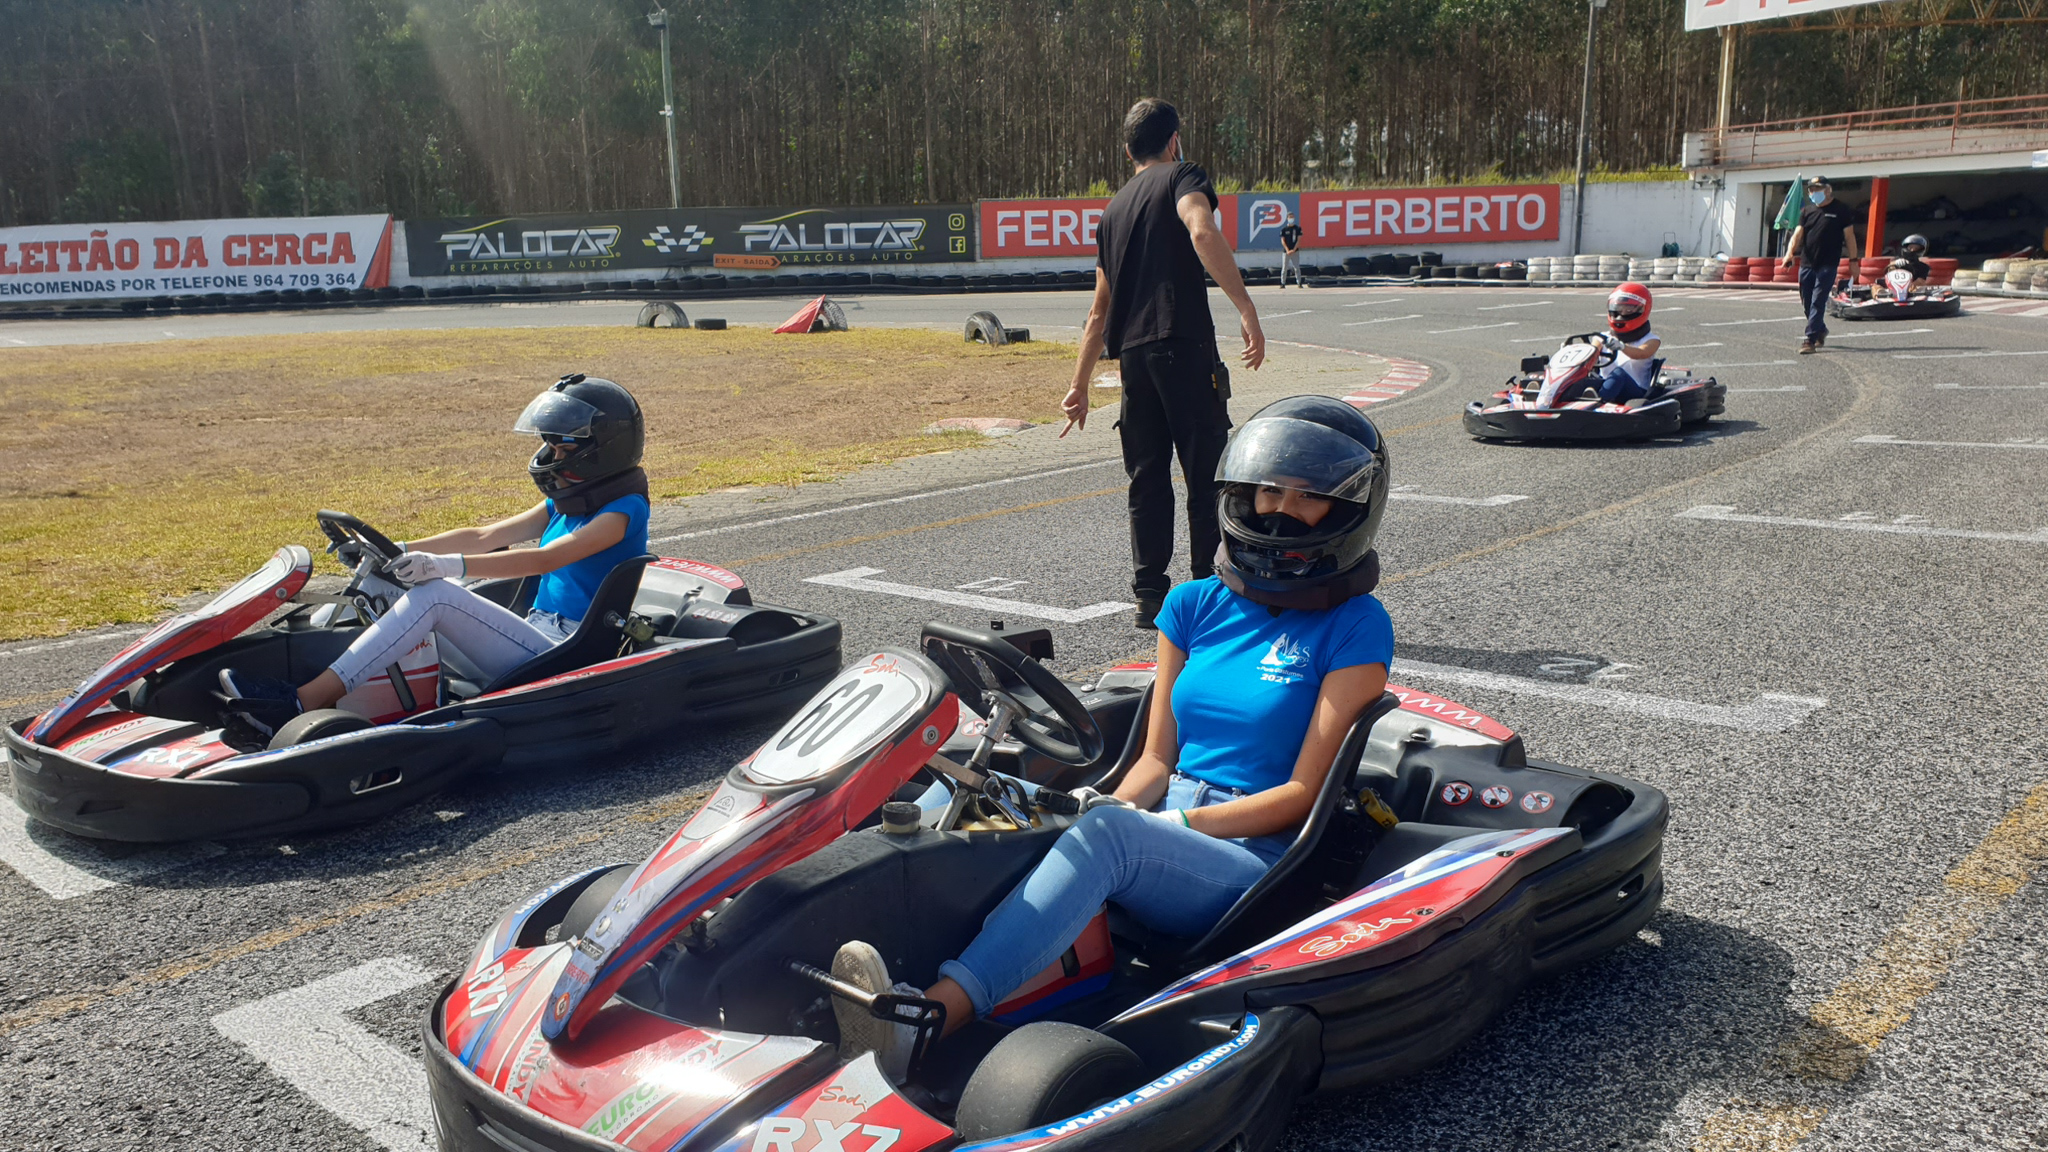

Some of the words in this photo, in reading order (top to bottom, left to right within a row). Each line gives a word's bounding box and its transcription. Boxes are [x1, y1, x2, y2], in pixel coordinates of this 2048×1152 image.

[1317, 193, 1546, 237] FERBERTO
[0, 229, 140, 275] LEITÃO
[153, 236, 209, 270] DA
[222, 231, 357, 268] CERCA
[440, 227, 620, 261] PALOCAR
[739, 221, 925, 252] PALOCAR
[450, 260, 553, 273] REPARAÇÕES
[568, 259, 610, 269] AUTO
[714, 257, 736, 265] EXIT
[743, 257, 771, 266] SAÍDA
[781, 252, 855, 264] ARAÇÕES
[871, 252, 913, 261] AUTO
[0, 279, 116, 296] ENCOMENDAS
[121, 278, 157, 291] POR
[163, 274, 248, 290] TELEFONE
[253, 274, 284, 287] 964
[291, 273, 320, 286] 709
[325, 272, 357, 286] 364
[1560, 348, 1583, 364] 67
[1260, 673, 1291, 684] 2021
[776, 678, 884, 758] 60
[135, 746, 211, 771] RX7
[467, 960, 509, 1019] RX7
[1046, 1023, 1260, 1137] WWW.EUROINDY.COM
[751, 1116, 902, 1152] RX7
